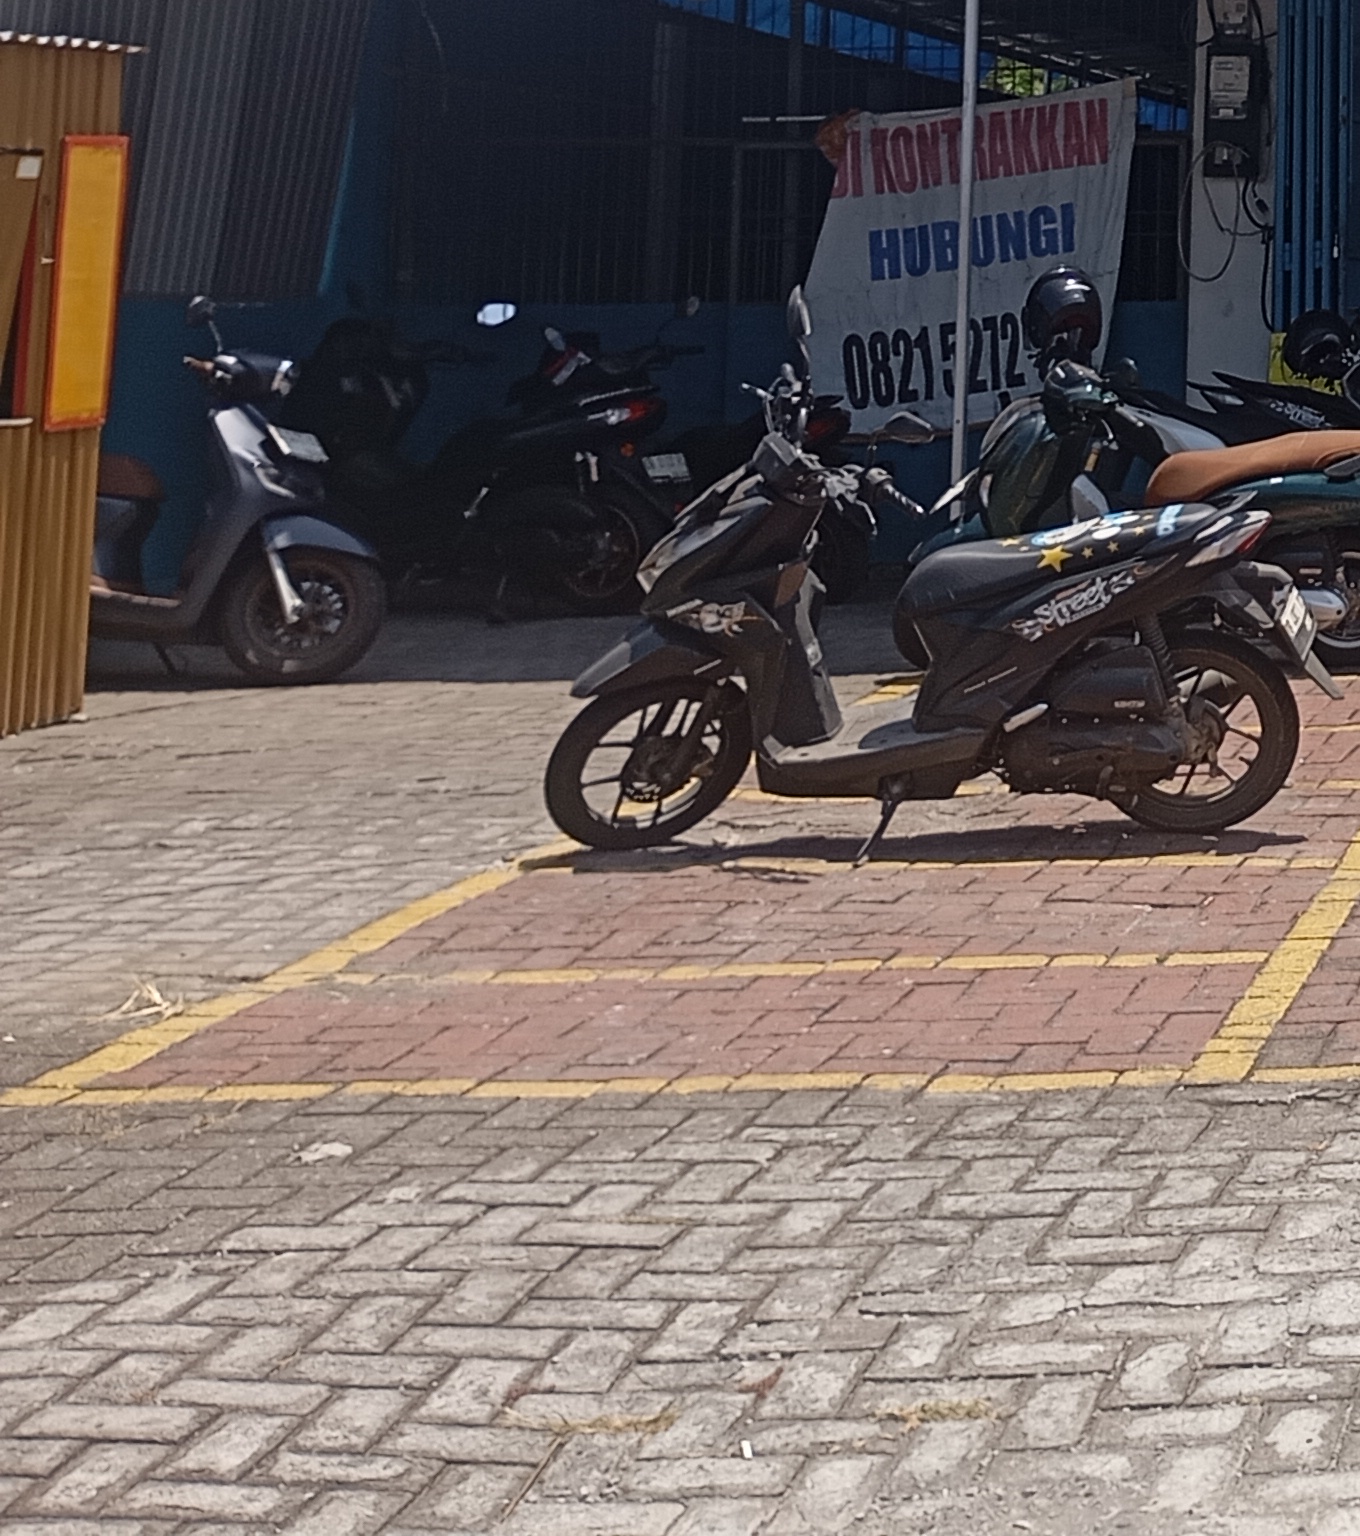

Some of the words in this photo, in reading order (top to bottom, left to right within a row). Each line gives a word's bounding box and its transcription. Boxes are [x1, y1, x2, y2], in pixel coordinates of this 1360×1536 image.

[870, 97, 1110, 196] KONTRAKKAN
[868, 202, 1076, 282] HUBUNGI
[843, 325, 934, 410] 0821
